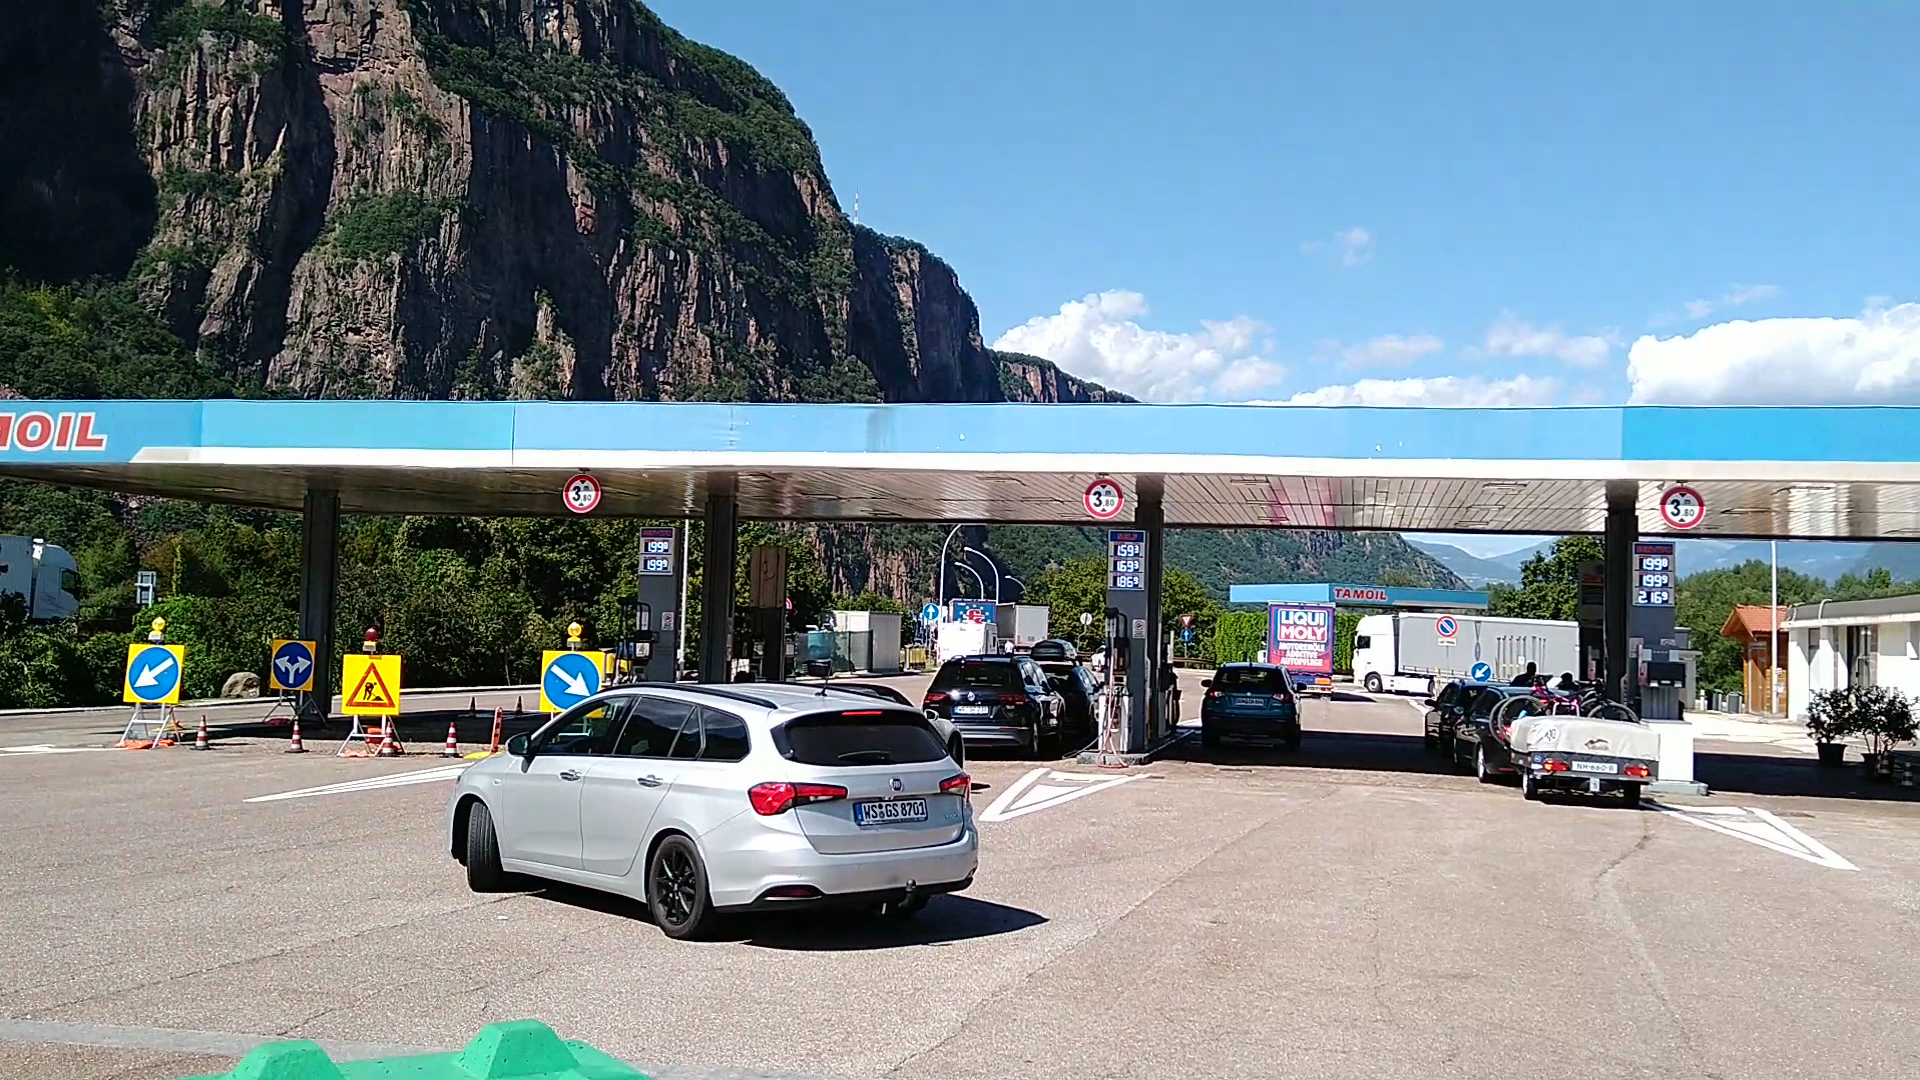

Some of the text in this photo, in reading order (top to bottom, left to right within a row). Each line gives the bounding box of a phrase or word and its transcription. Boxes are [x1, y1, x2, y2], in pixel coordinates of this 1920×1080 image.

[1334, 587, 1388, 601] TAMOIL
[1280, 610, 1325, 626] LIQUI
[1280, 626, 1325, 641] MOLY
